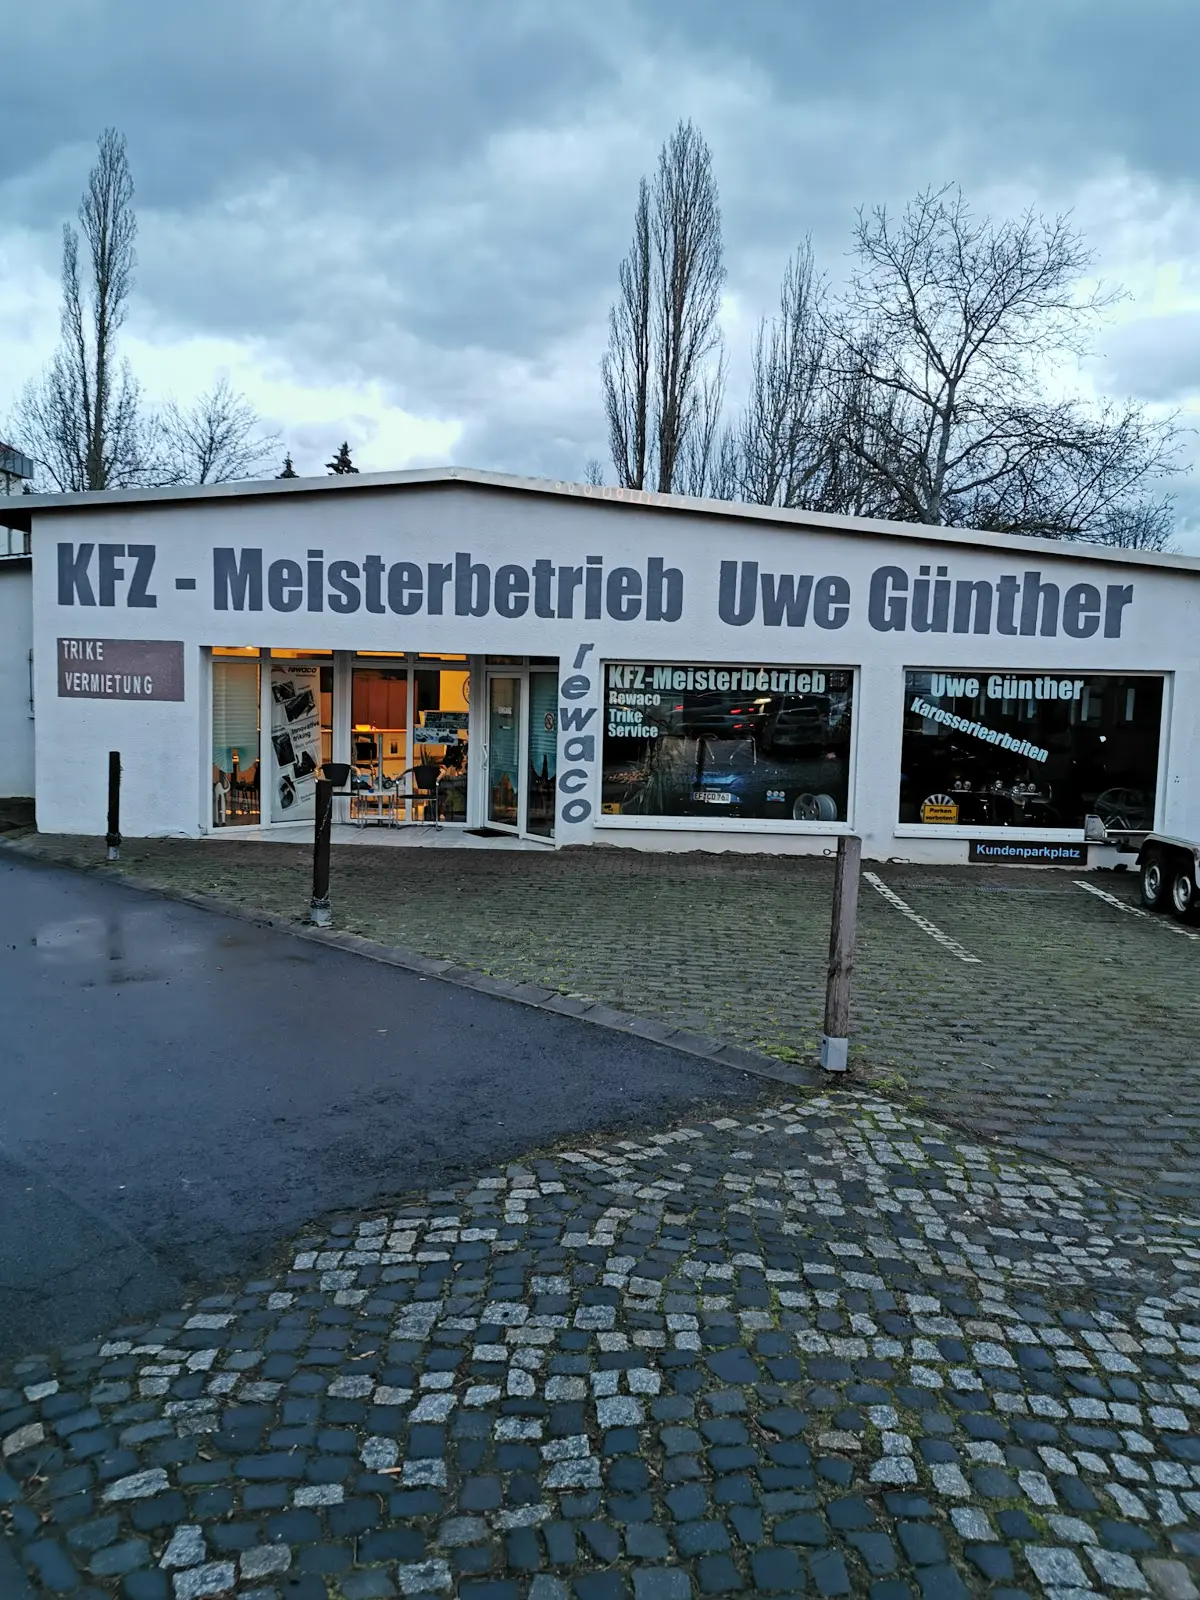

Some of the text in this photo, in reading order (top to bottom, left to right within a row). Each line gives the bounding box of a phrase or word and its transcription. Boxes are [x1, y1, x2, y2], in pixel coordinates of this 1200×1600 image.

[57, 542, 157, 608] KFZ
[213, 547, 684, 622] Meisterbetrieb
[718, 560, 851, 630] Uwe
[868, 565, 1134, 639] Günther
[62, 640, 104, 661] TRIKE
[65, 672, 153, 695] VERMIETUNG
[608, 665, 826, 693] KFZ-Meisterbetrieb
[930, 673, 1084, 700] Uwe Günther
[609, 691, 661, 706] Rewaco
[609, 708, 643, 723] Trike
[559, 642, 597, 824] rewaco
[608, 723, 659, 738] Service
[910, 696, 1049, 763] Karosseriearbeiten
[976, 844, 1080, 859] Kundenparkplatz
